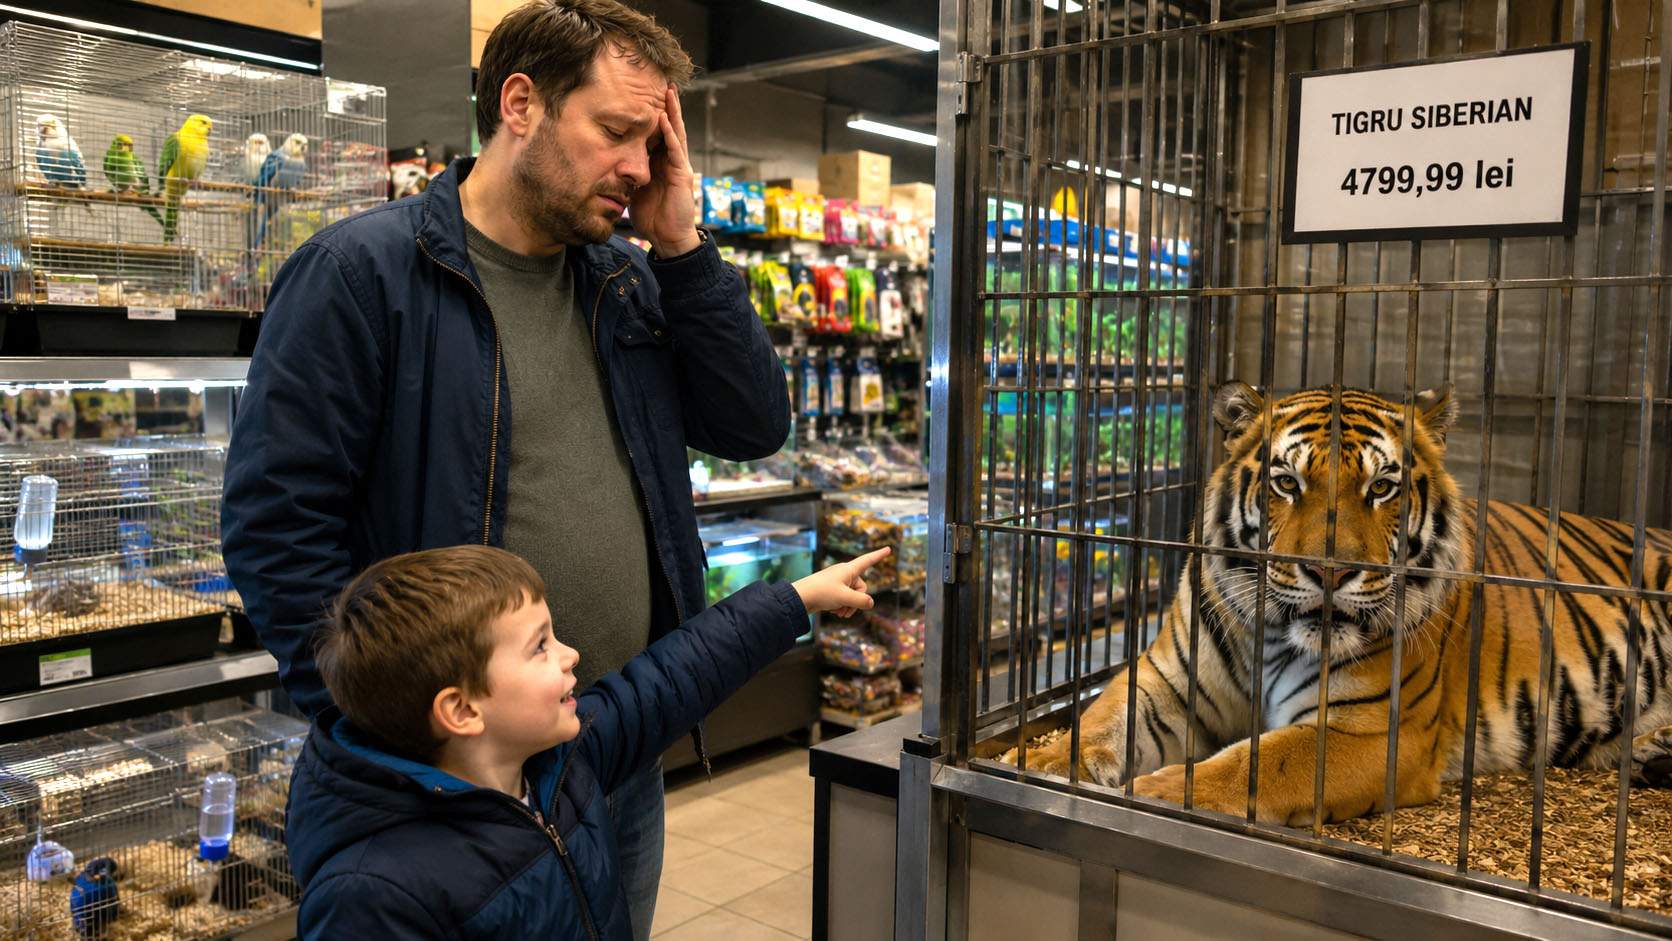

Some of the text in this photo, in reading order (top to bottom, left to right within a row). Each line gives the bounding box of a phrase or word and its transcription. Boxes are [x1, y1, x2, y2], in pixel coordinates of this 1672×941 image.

[1331, 96, 1534, 136] TIGRU SIBERIAN
[1340, 157, 1515, 198] 4799,99 lei
